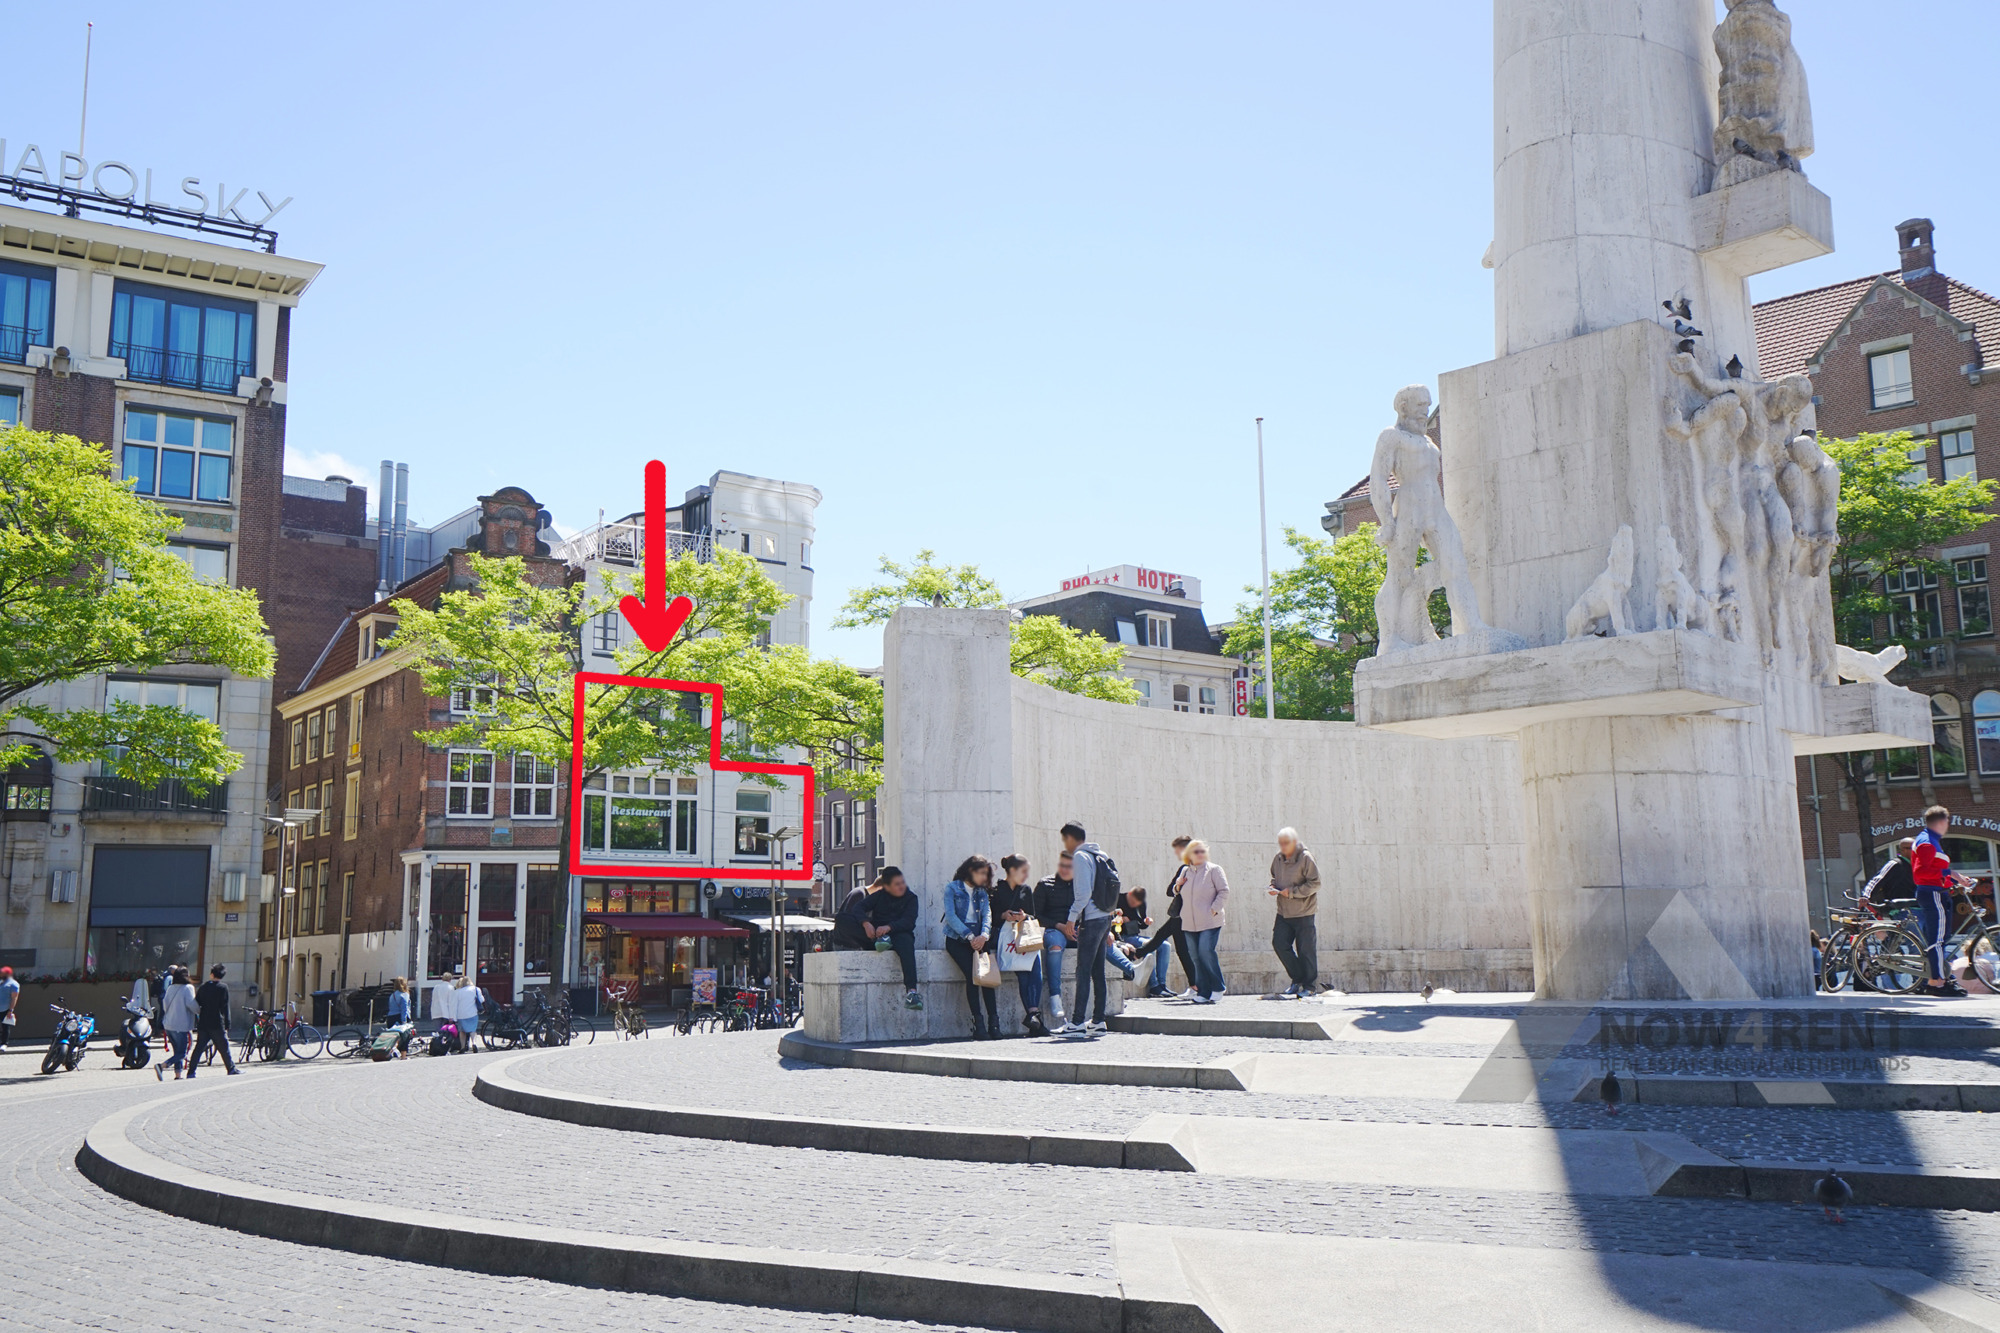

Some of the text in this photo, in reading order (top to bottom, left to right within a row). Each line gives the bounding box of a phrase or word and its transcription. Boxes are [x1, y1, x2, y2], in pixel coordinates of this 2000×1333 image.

[0, 138, 294, 226] APOLSKY
[1137, 567, 1182, 591] HOTE
[611, 805, 671, 817] Restaurant
[1950, 815, 1962, 826] It
[1964, 818, 1979, 827] or
[626, 886, 670, 899] Happiness
